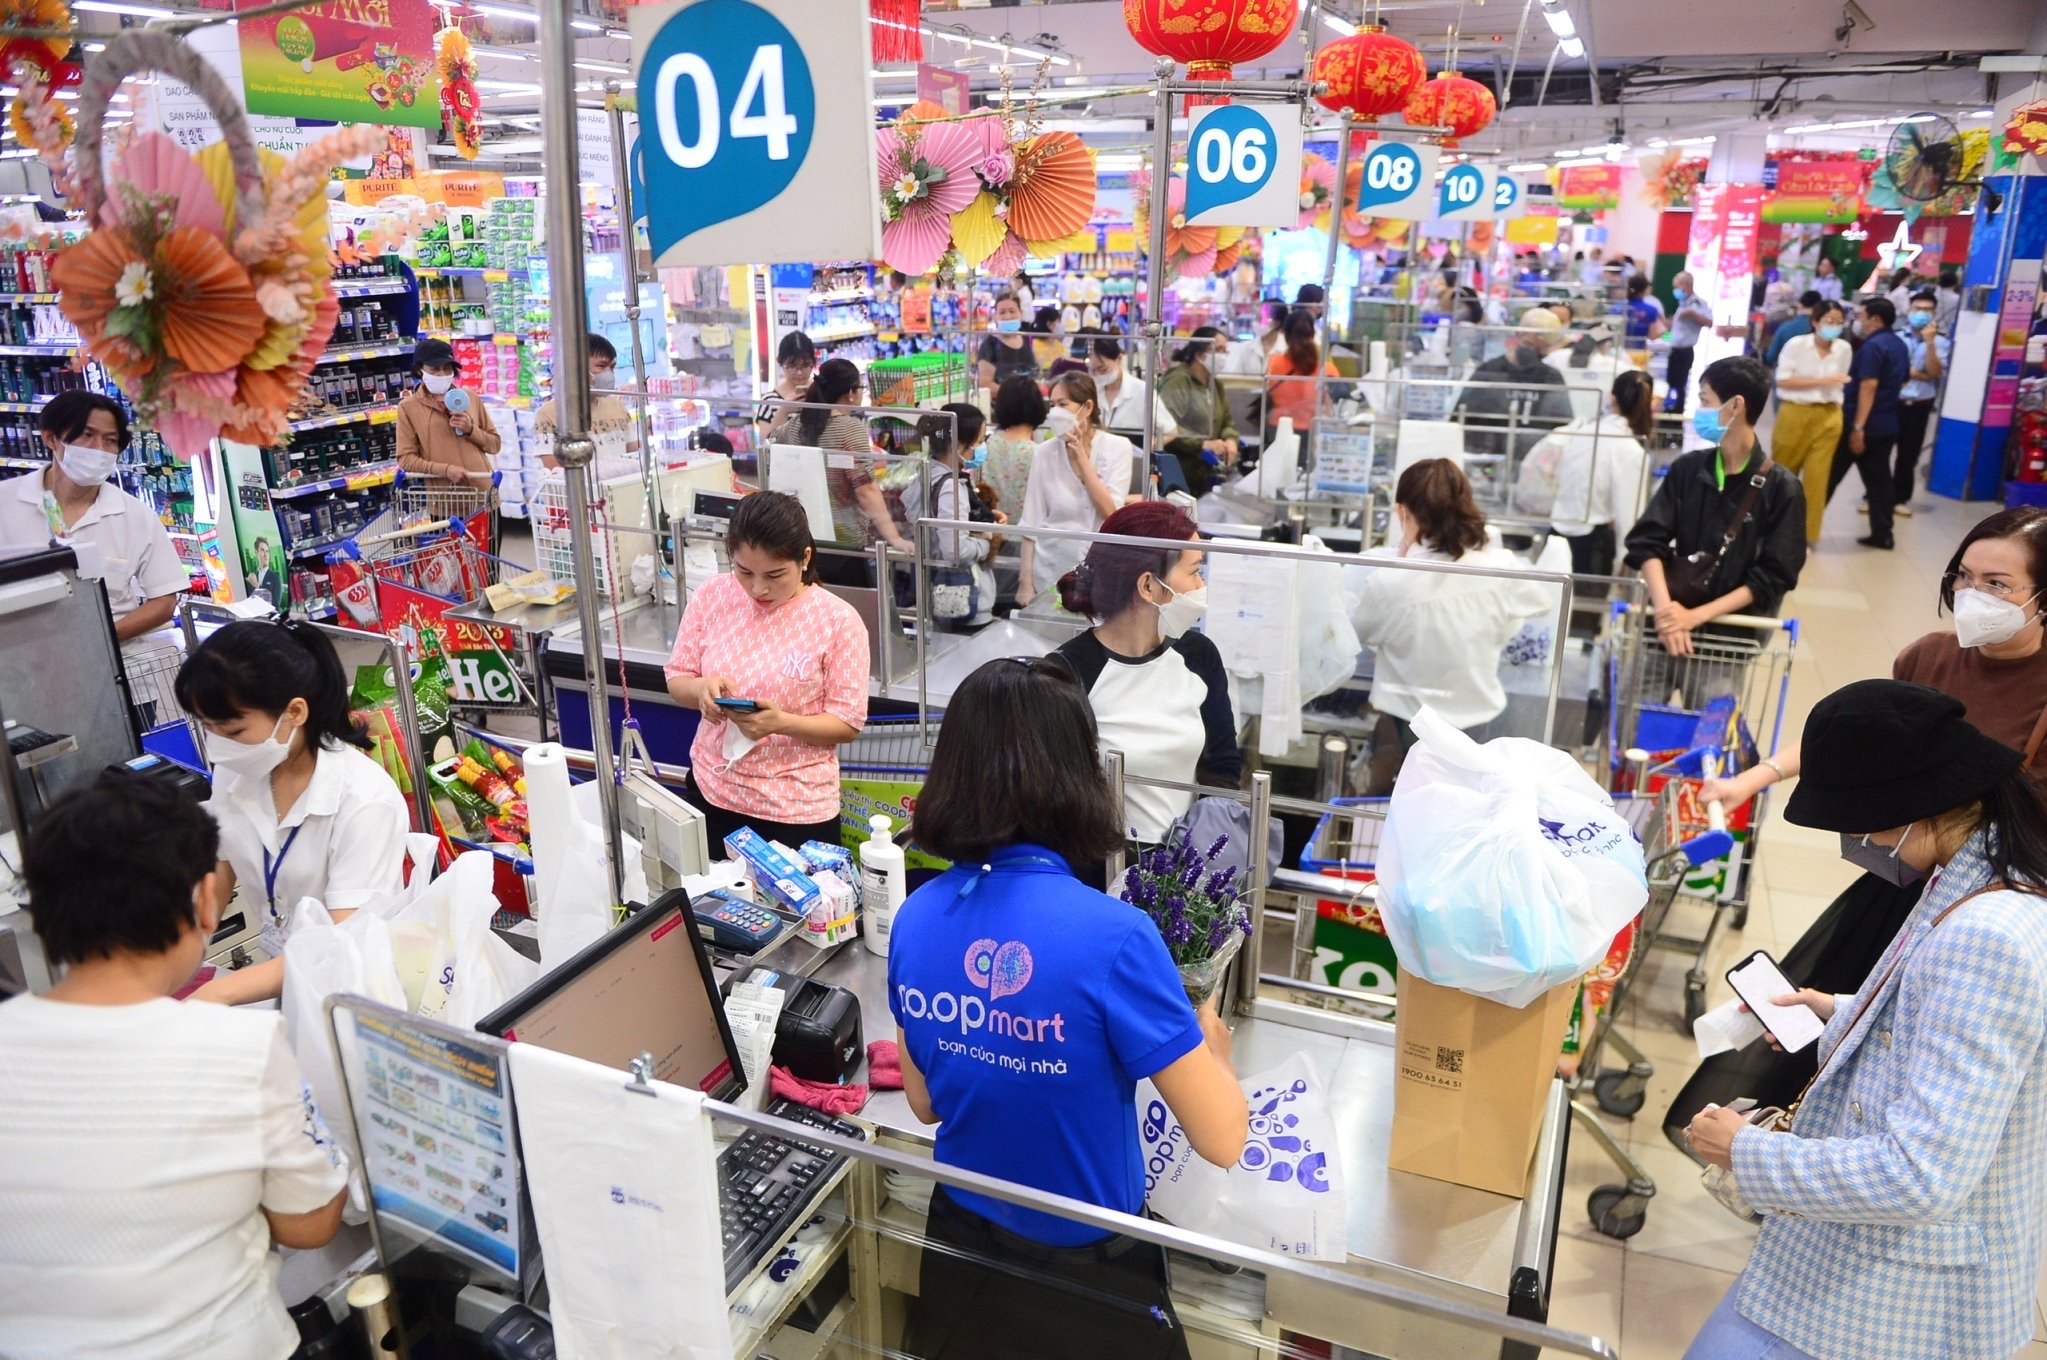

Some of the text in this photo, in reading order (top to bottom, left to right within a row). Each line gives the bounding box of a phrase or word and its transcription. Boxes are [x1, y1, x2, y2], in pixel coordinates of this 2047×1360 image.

[165, 87, 181, 97] DAO
[655, 44, 797, 168] 04
[1197, 128, 1267, 184] 06
[1367, 154, 1415, 192] 08
[1445, 175, 1478, 202] 10
[1495, 183, 1512, 204] 2
[456, 622, 504, 641] 203
[938, 1038, 967, 1056] bạn
[970, 1045, 995, 1065] của
[1000, 1054, 1026, 1074] mọi
[1401, 1067, 1423, 1079] 1900
[1438, 1078, 1450, 1086] 64
[1453, 1080, 1462, 1088] 31
[1170, 1164, 1185, 1183] bạn
